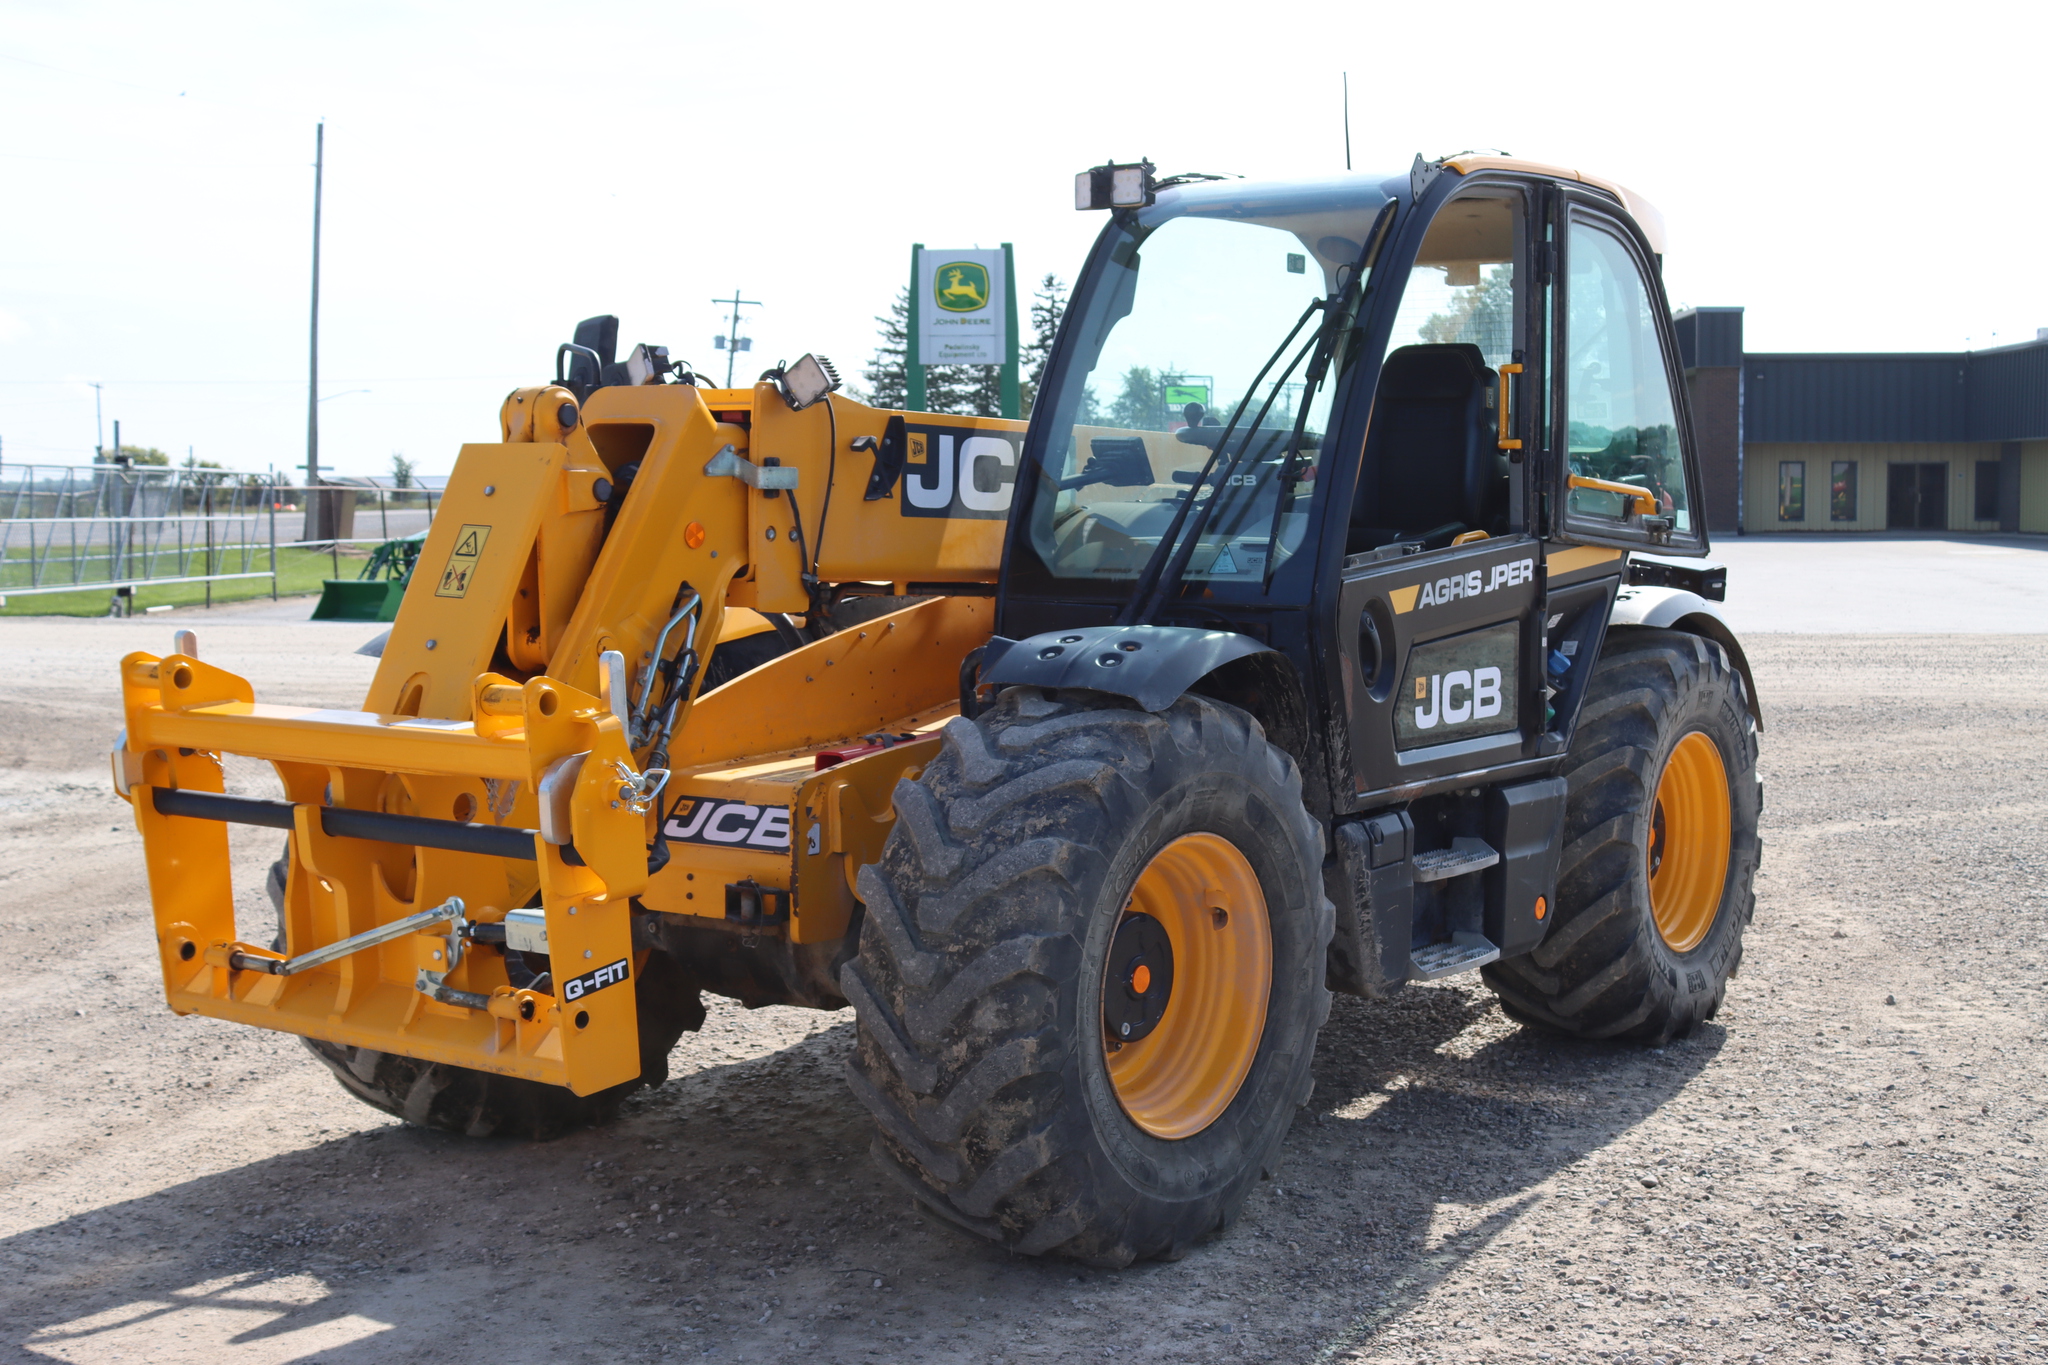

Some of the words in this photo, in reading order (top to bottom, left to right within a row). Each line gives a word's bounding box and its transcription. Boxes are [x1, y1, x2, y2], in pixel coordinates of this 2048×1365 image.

[933, 317, 959, 325] JOHN
[960, 317, 991, 325] DEERE
[938, 351, 975, 359] Equipment
[906, 434, 1025, 511] JC
[1415, 666, 1502, 729] JCB
[663, 802, 790, 848] JCB
[565, 960, 627, 1000] Q-FIT
